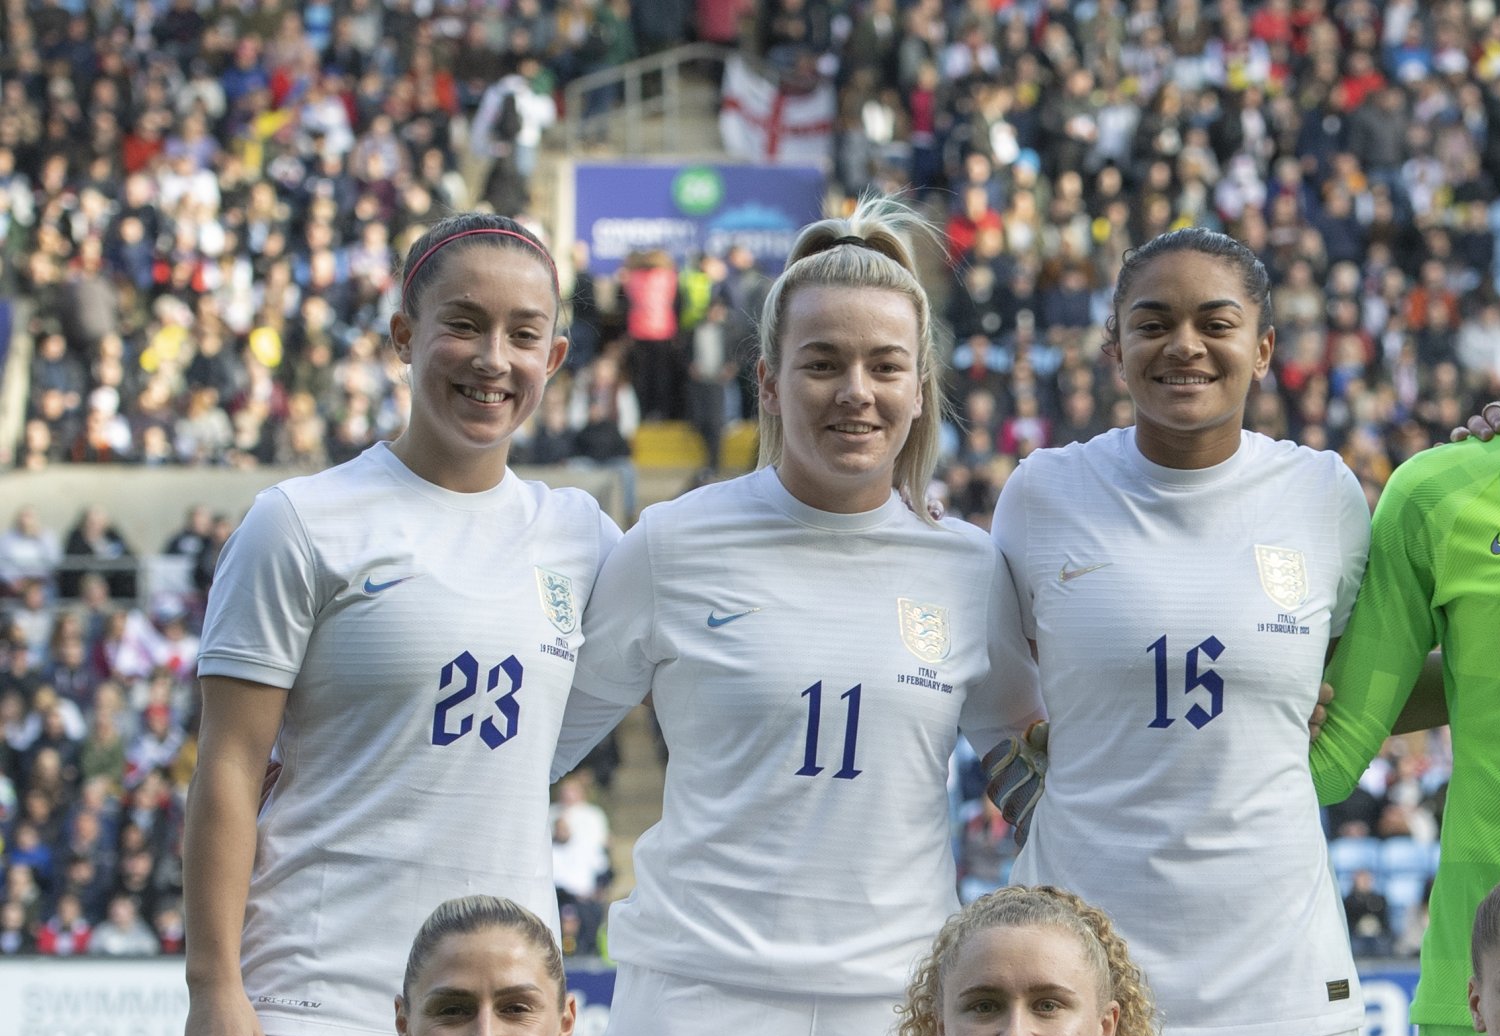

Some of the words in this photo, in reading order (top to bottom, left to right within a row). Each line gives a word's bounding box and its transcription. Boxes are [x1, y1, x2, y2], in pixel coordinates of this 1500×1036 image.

[1277, 613, 1297, 624] ITALY
[1257, 623, 1265, 632] 19
[1266, 623, 1299, 635] FEBRUARY
[918, 667, 937, 680] ITALY
[1147, 635, 1225, 729] 15
[897, 674, 905, 683] 19
[906, 675, 941, 691] FEBRUARY
[432, 651, 523, 750] 23
[795, 681, 862, 779] 11
